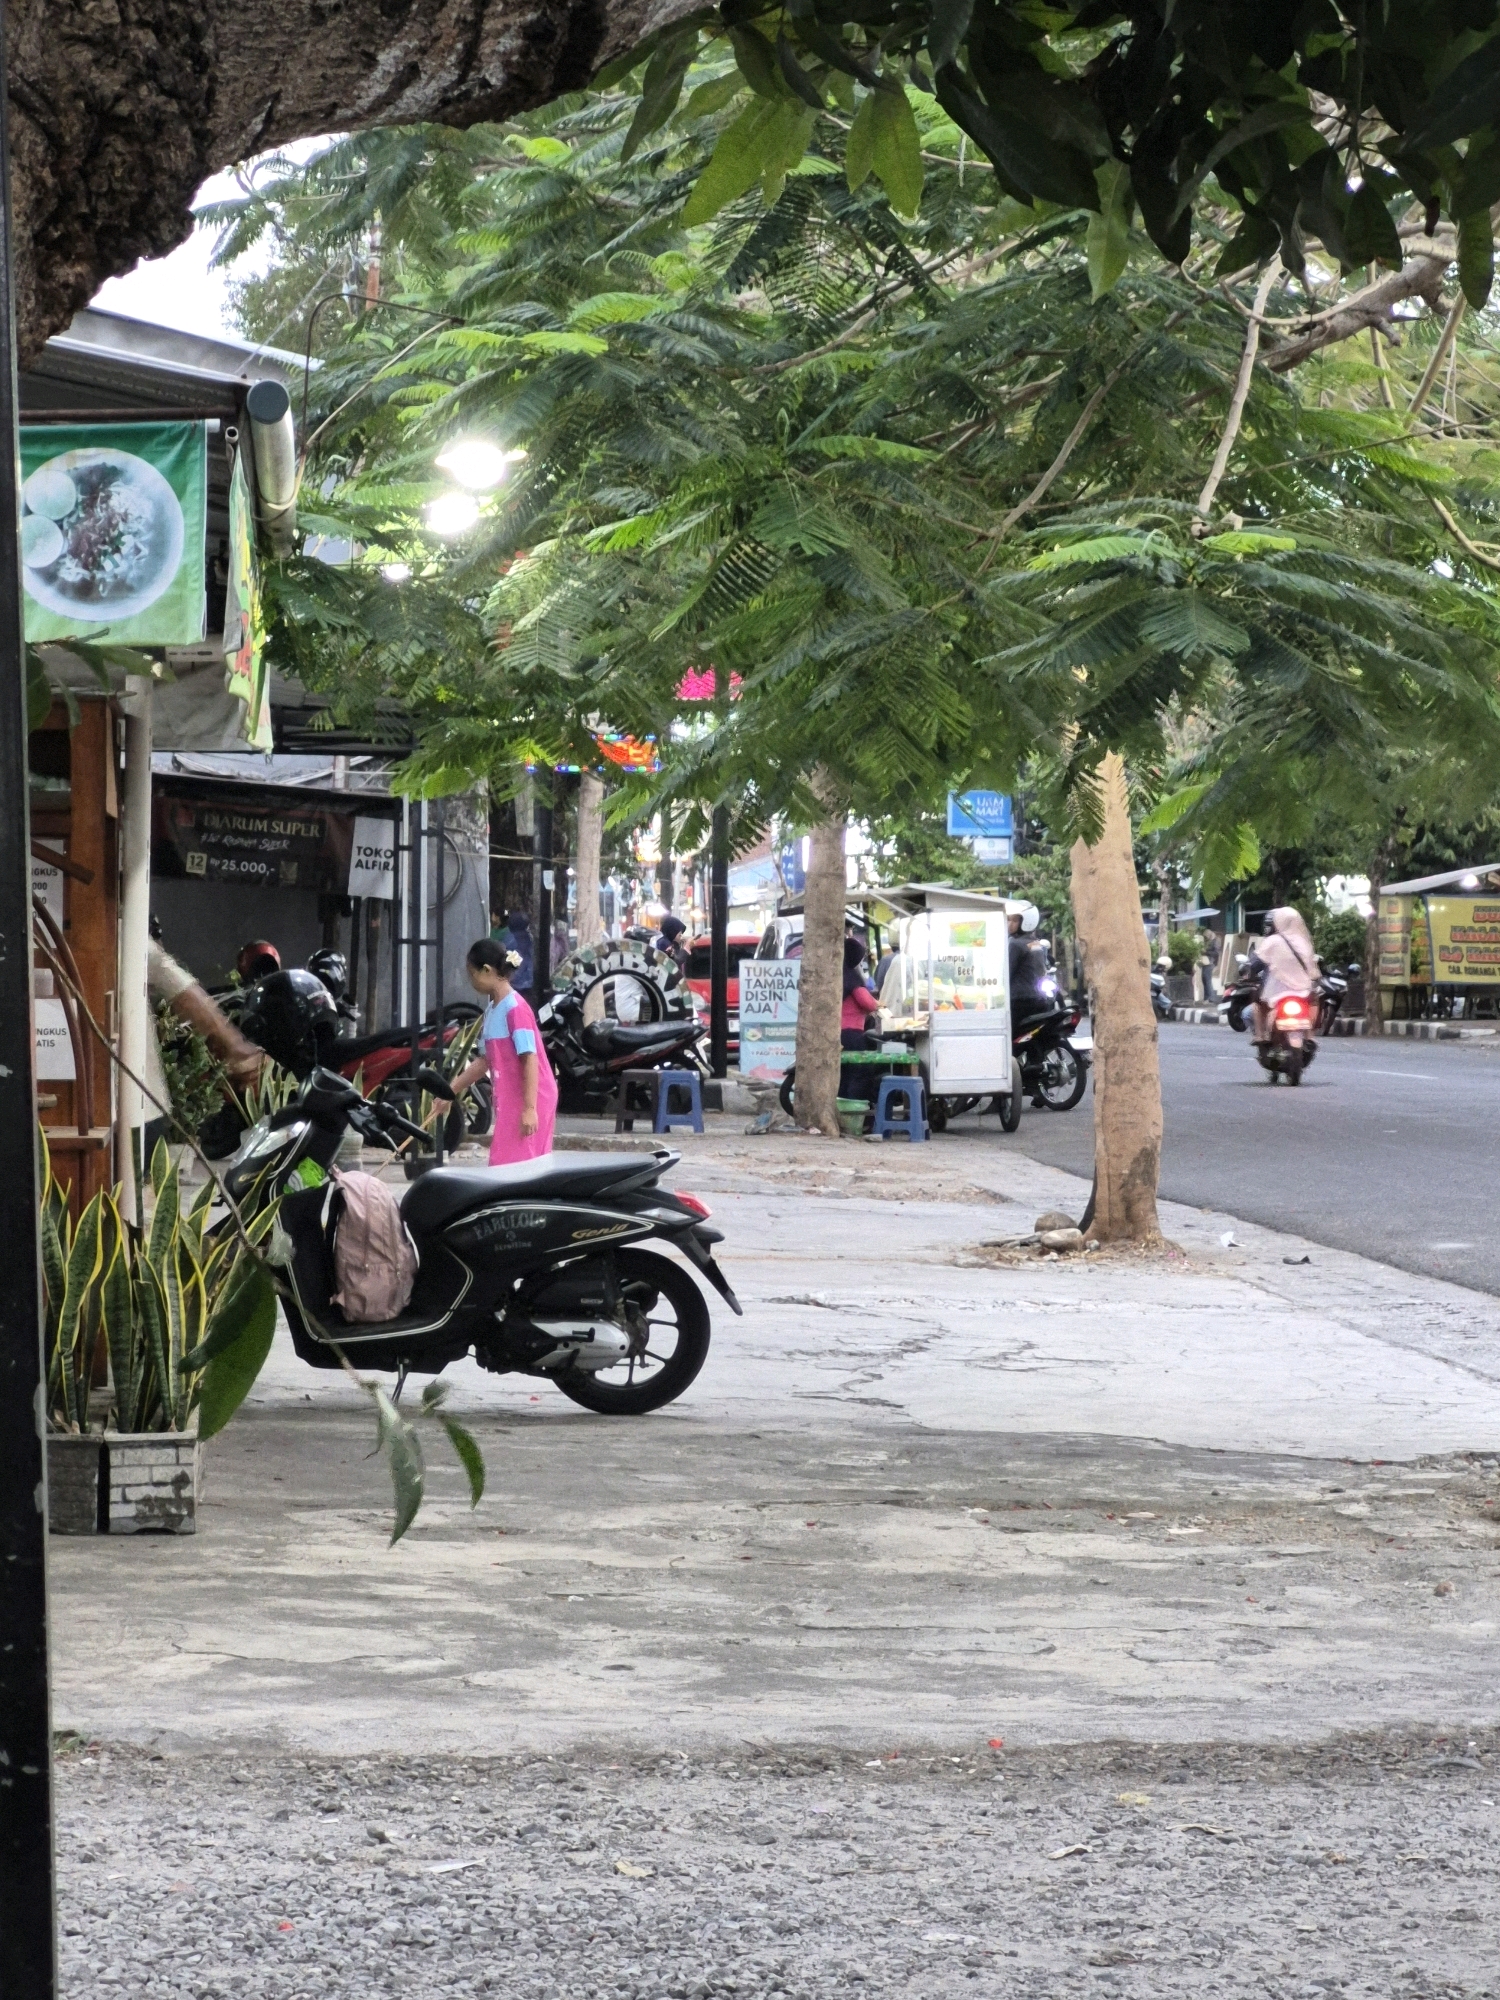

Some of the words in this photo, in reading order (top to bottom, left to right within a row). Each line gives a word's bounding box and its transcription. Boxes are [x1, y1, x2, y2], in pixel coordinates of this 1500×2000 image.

[203, 813, 269, 833] DJARUM
[270, 820, 321, 838] SUPER
[356, 845, 395, 859] TOKO
[189, 854, 204, 867] 12
[937, 954, 965, 965] Lumpia
[744, 966, 793, 978] TUKAR
[957, 966, 975, 976] Beef
[568, 950, 684, 1012] AMBAL
[745, 990, 787, 1002] DISINI
[744, 1002, 779, 1019] AJA!
[571, 1223, 630, 1239] Genio
